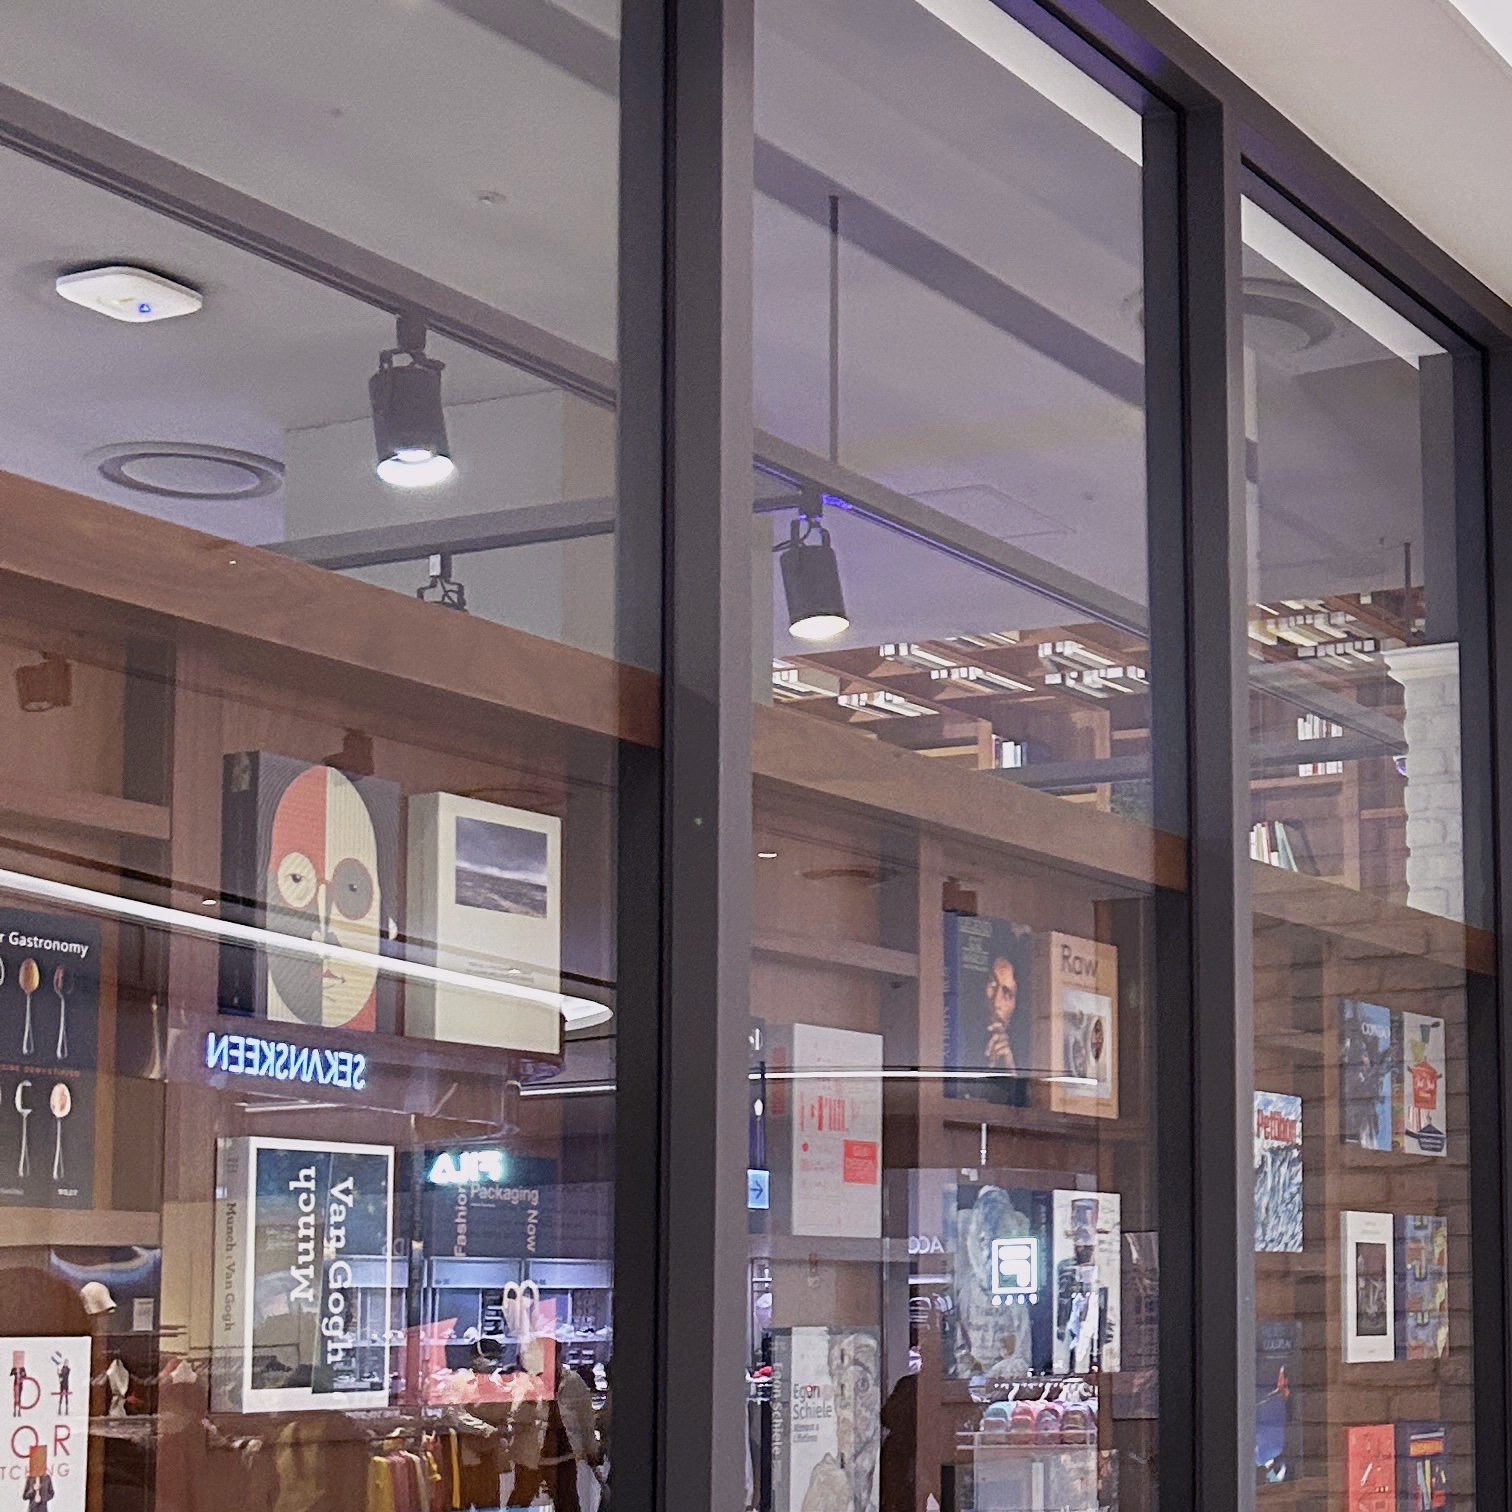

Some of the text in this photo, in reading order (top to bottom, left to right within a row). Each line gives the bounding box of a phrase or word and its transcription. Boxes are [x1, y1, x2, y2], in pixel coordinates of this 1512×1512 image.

[9, 931, 88, 957] Gastronomy
[1061, 943, 1098, 977] Raw
[470, 1184, 539, 1206] Packaging
[290, 1166, 316, 1302] Munch
[526, 1209, 539, 1253] Now
[223, 1203, 238, 1332] Munch Van Gogh
[321, 1176, 354, 1365] Van Gogh
[793, 1384, 820, 1403] Egon
[793, 1401, 832, 1420] Schiele
